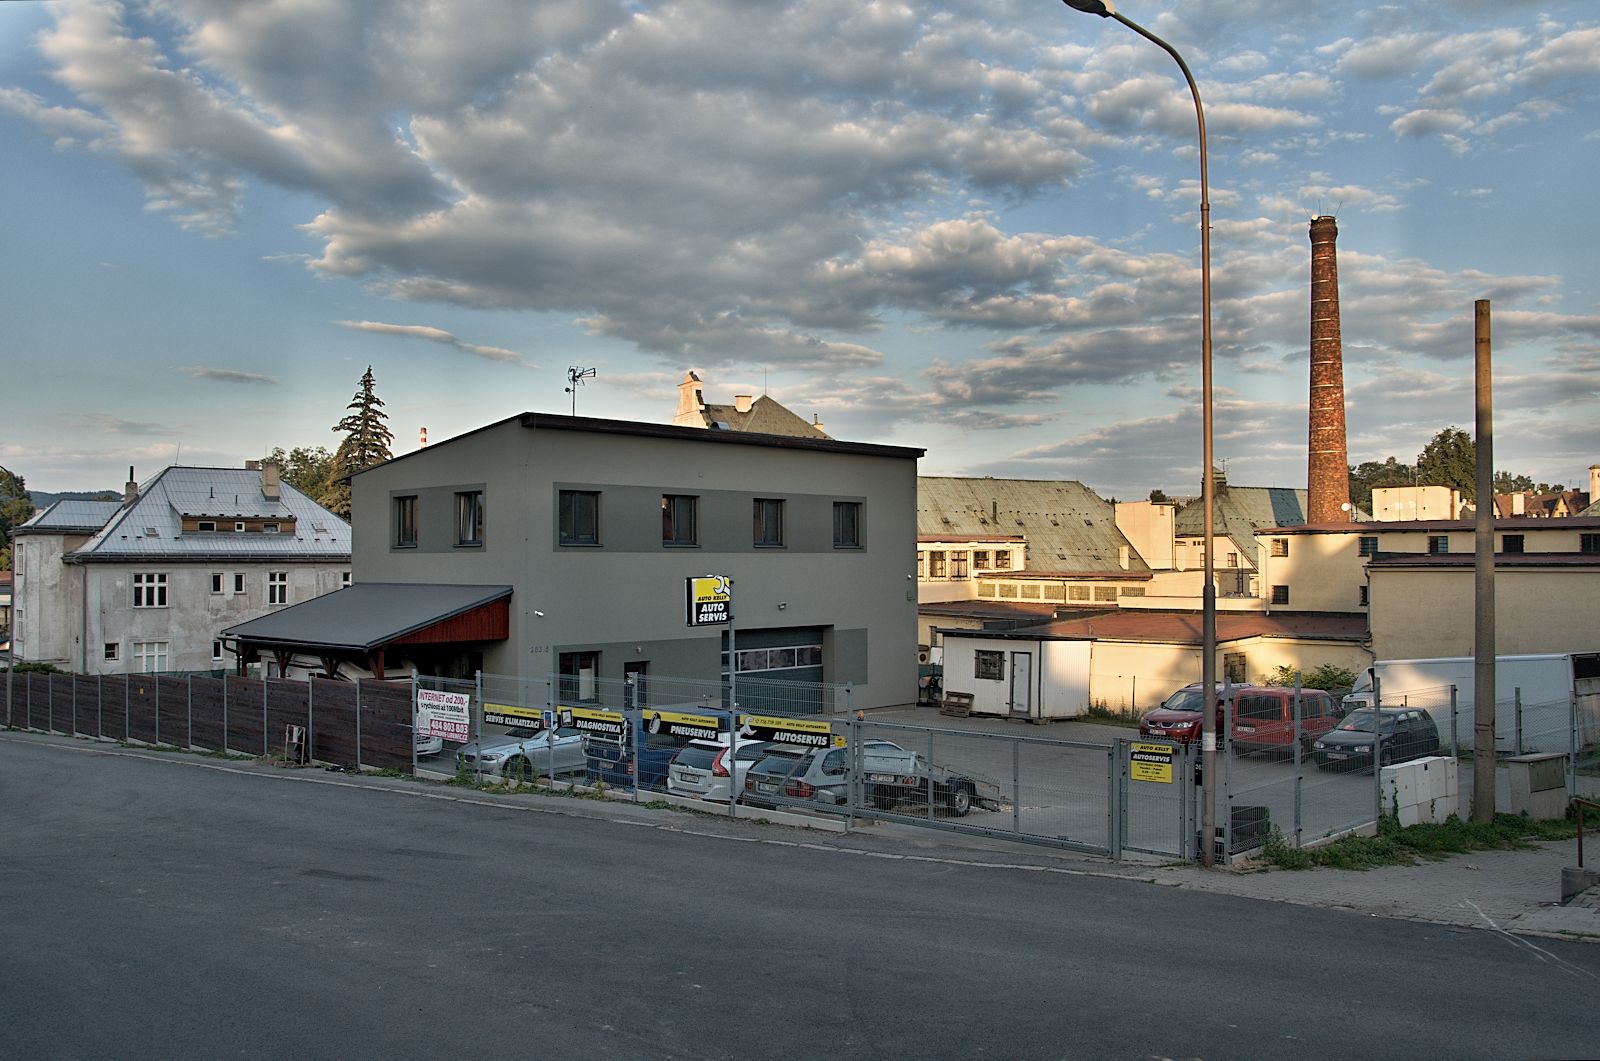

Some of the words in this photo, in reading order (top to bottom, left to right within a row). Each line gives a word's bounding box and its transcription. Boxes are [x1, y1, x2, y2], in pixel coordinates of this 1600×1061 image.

[701, 603, 724, 612] AUTO
[699, 612, 727, 622] SERVIS
[419, 691, 445, 702] INTERNET
[446, 695, 453, 703] od
[486, 714, 504, 724] SERVIS
[576, 720, 621, 733] DIAGNOSTIKA
[670, 725, 716, 739] PNEUSERVIS
[773, 731, 828, 746] AUTOSERVIS
[1133, 753, 1170, 762] AUTOSERVIS
